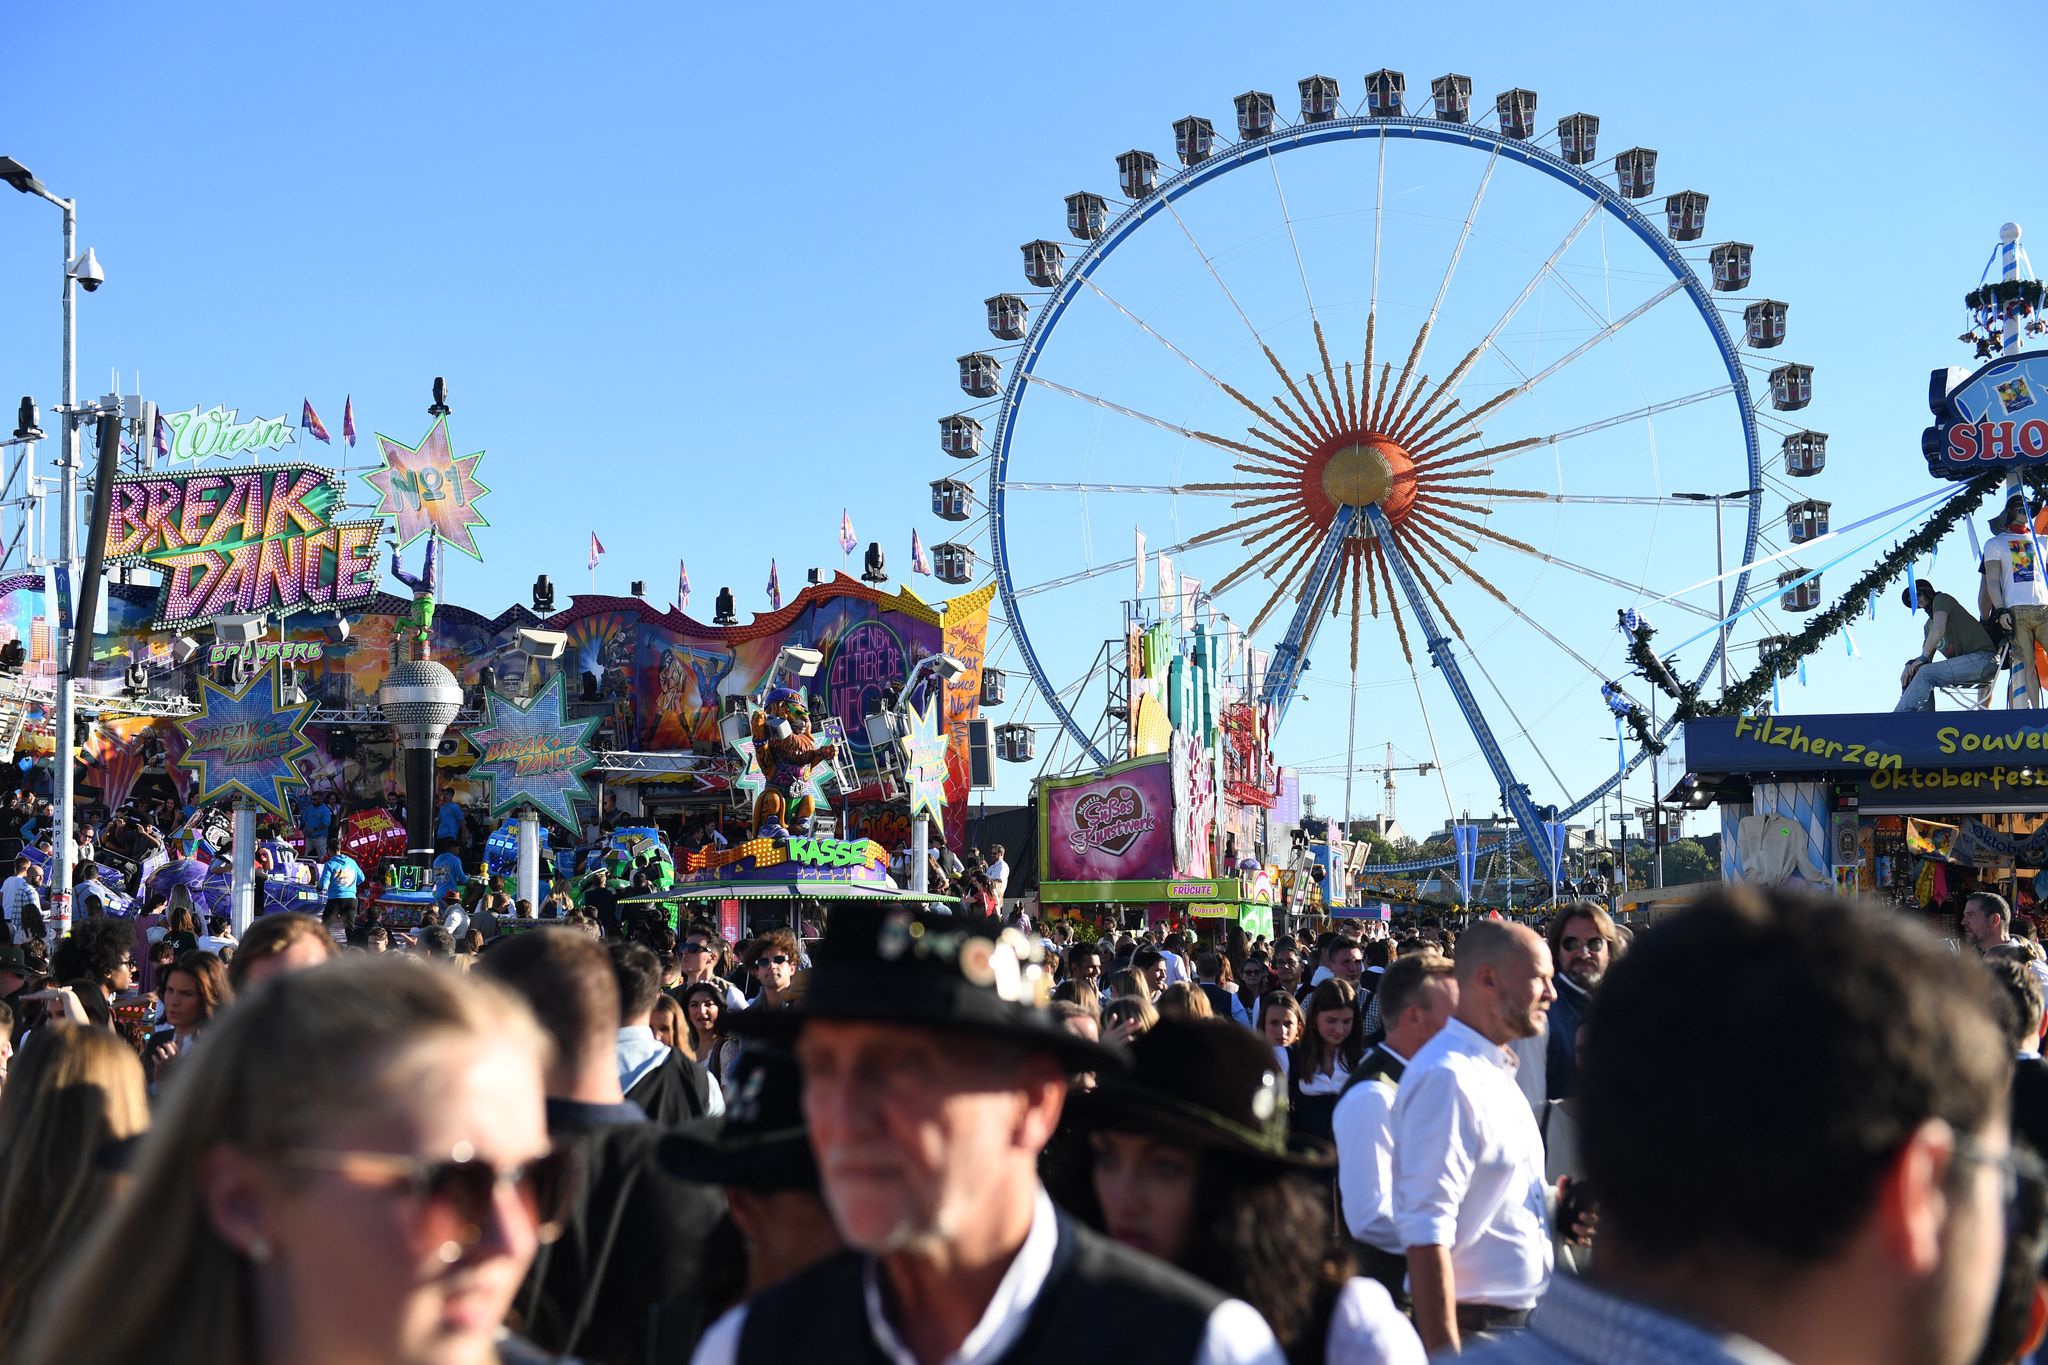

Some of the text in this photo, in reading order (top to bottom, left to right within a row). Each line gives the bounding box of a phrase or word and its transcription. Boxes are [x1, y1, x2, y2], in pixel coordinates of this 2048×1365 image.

[172, 405, 286, 459] Wiesn
[104, 469, 328, 557] BREAK
[151, 525, 377, 623] DANCE
[845, 626, 890, 652] THE NEW
[854, 650, 885, 681] THERE
[888, 647, 902, 676] BE
[196, 722, 259, 750] BREAK
[225, 732, 290, 763] DANCE
[485, 736, 550, 763] BREAK
[1735, 716, 1902, 770] Filzherzen
[515, 746, 578, 776] DANCE
[1870, 766, 2048, 790] Oktoberfest
[1069, 813, 1154, 855] Kunstwerk
[789, 838, 869, 865] KASSE
[1172, 884, 1212, 896] FRÜCHTE
